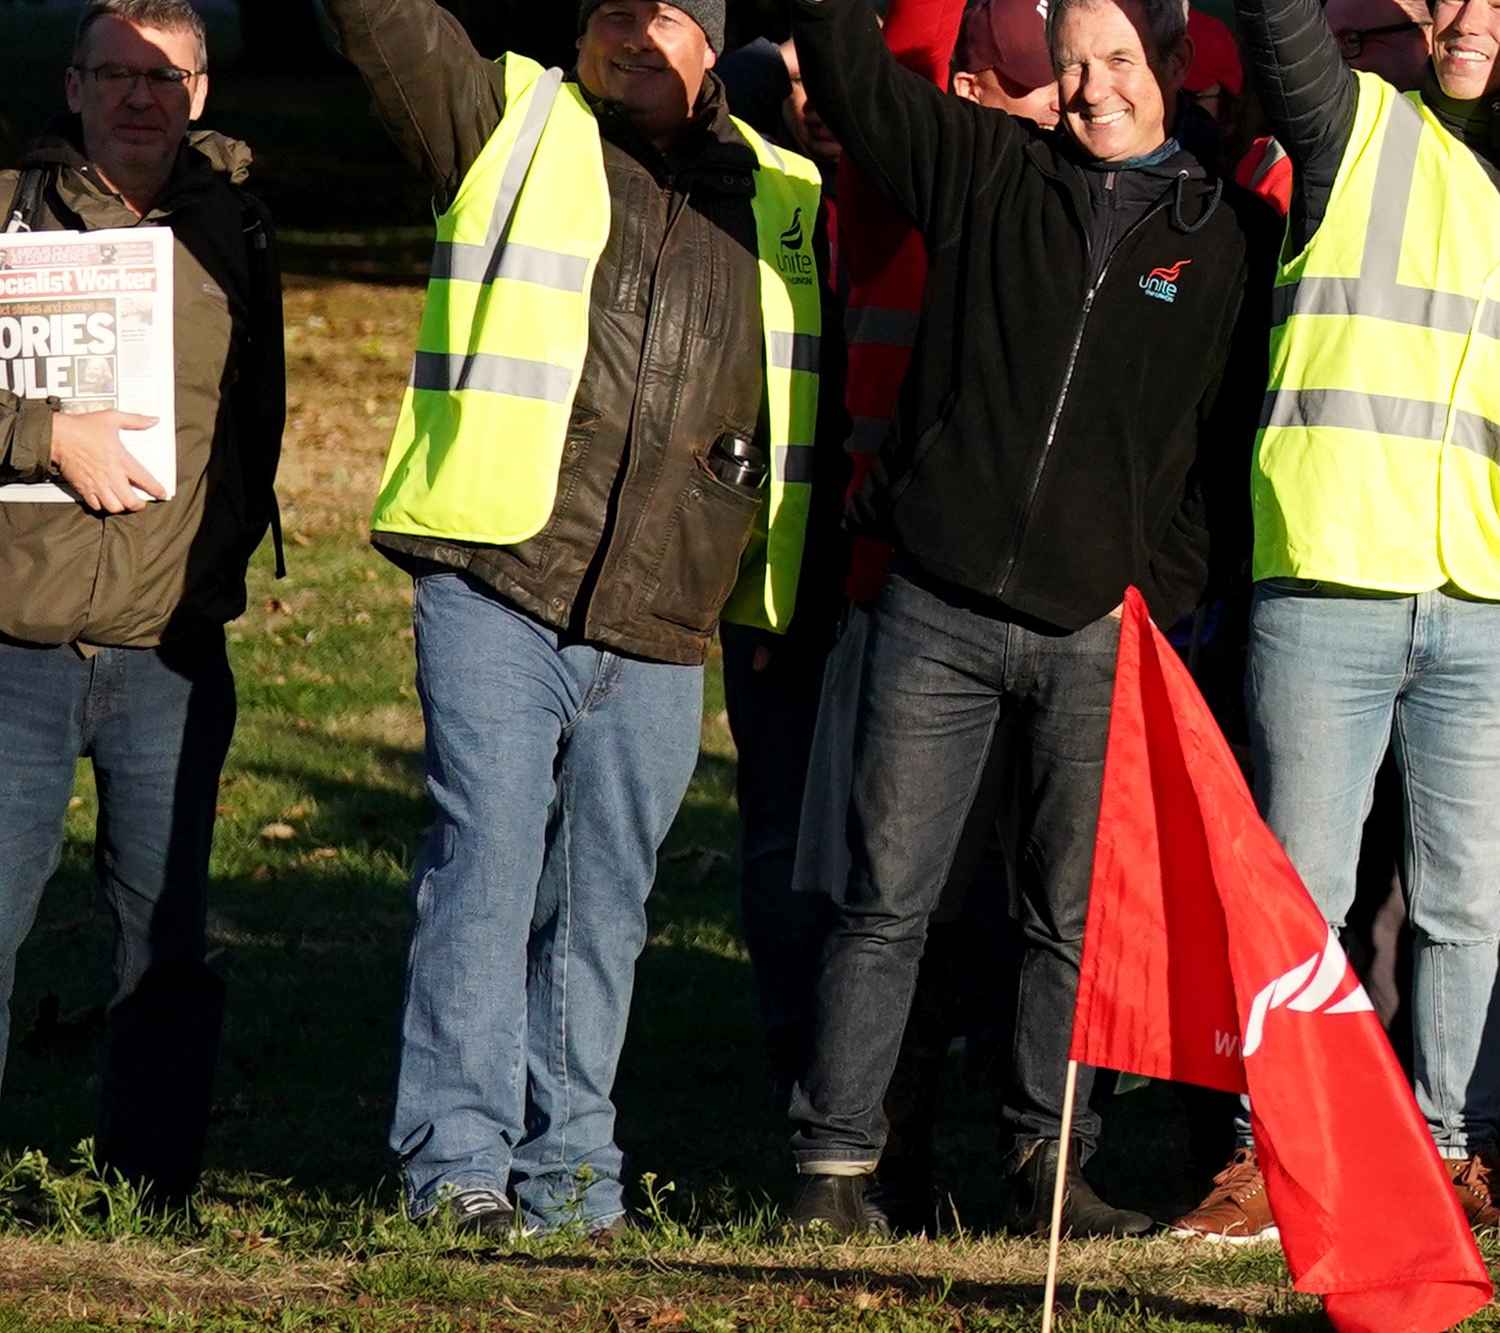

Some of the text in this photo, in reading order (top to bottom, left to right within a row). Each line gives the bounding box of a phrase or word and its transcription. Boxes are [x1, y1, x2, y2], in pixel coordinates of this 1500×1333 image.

[75, 266, 155, 293] Worker
[0, 312, 116, 360] ORIES
[0, 356, 73, 401] ULE
